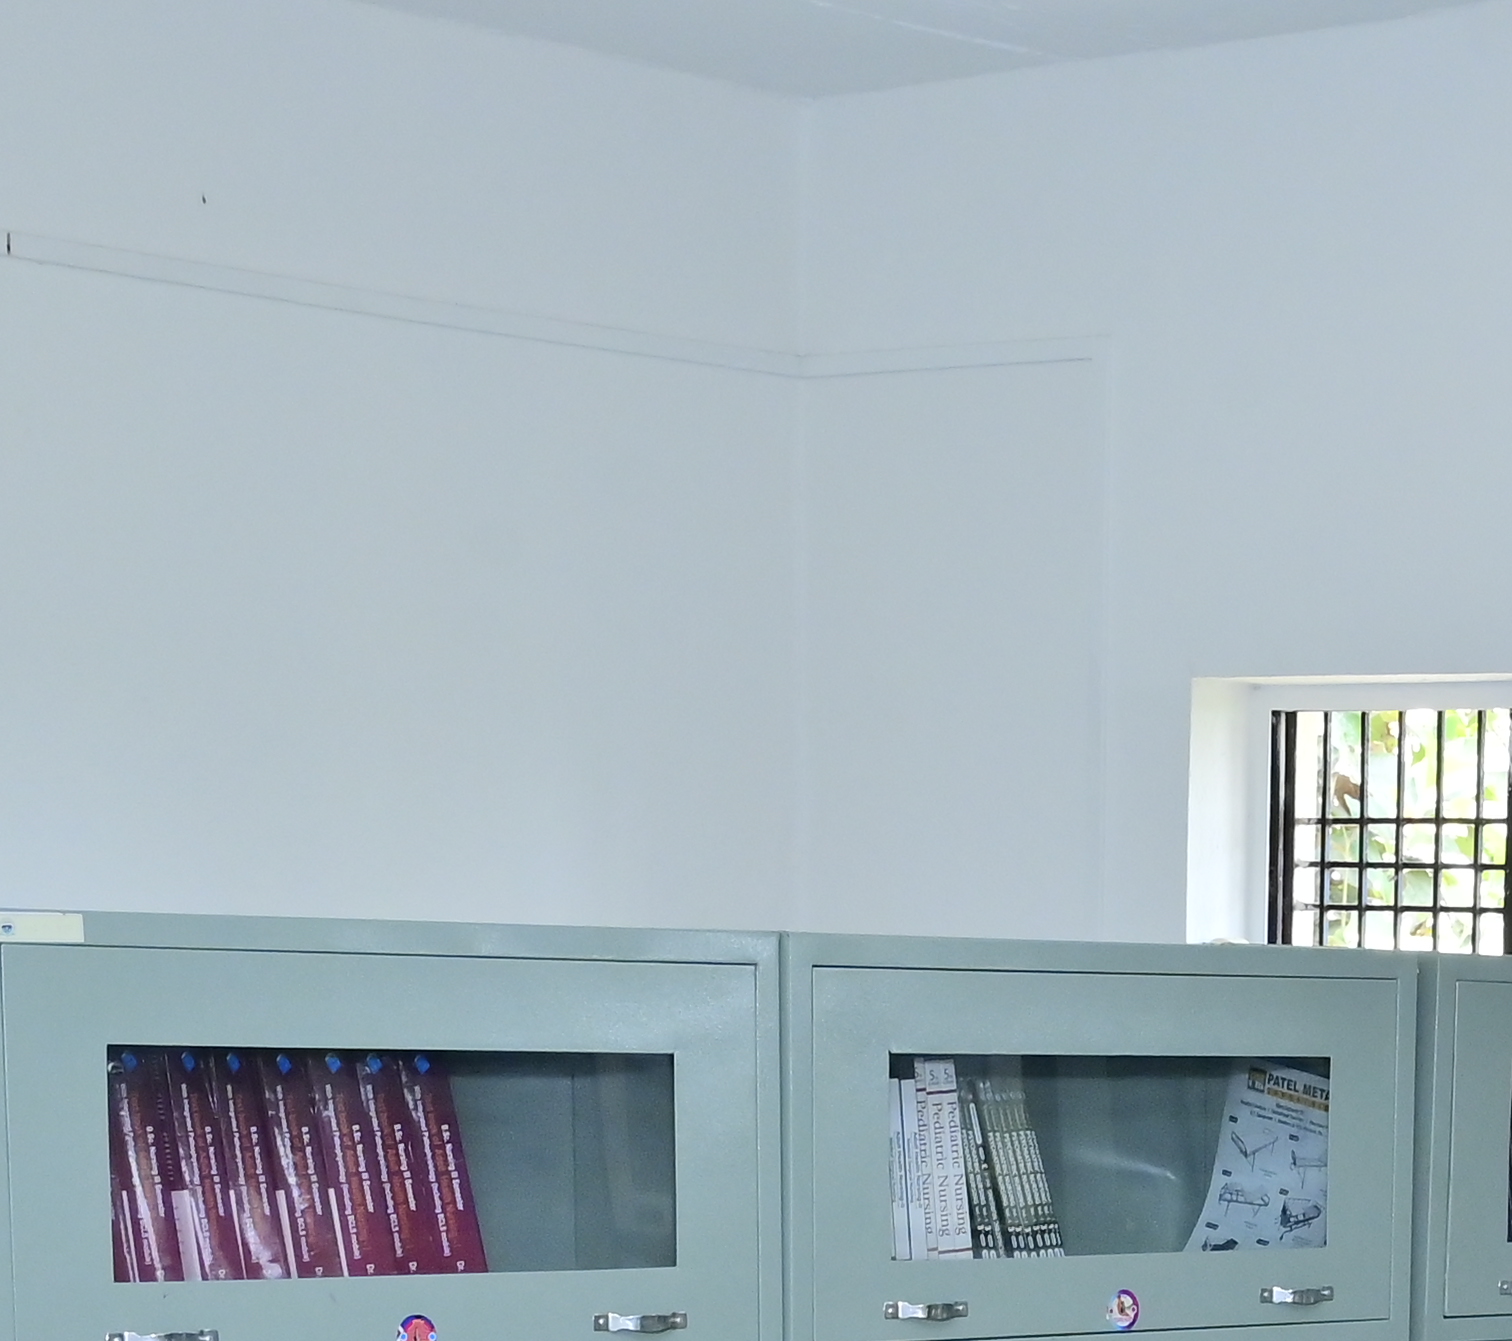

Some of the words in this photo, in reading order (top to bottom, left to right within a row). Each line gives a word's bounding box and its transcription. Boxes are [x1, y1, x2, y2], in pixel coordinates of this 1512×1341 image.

[1268, 1073, 1300, 1092] PATEL
[932, 1102, 947, 1170] Pediatric
[947, 1101, 962, 1169] Pediatric
[938, 1175, 952, 1237] Nursing
[954, 1174, 966, 1236] Nursing
